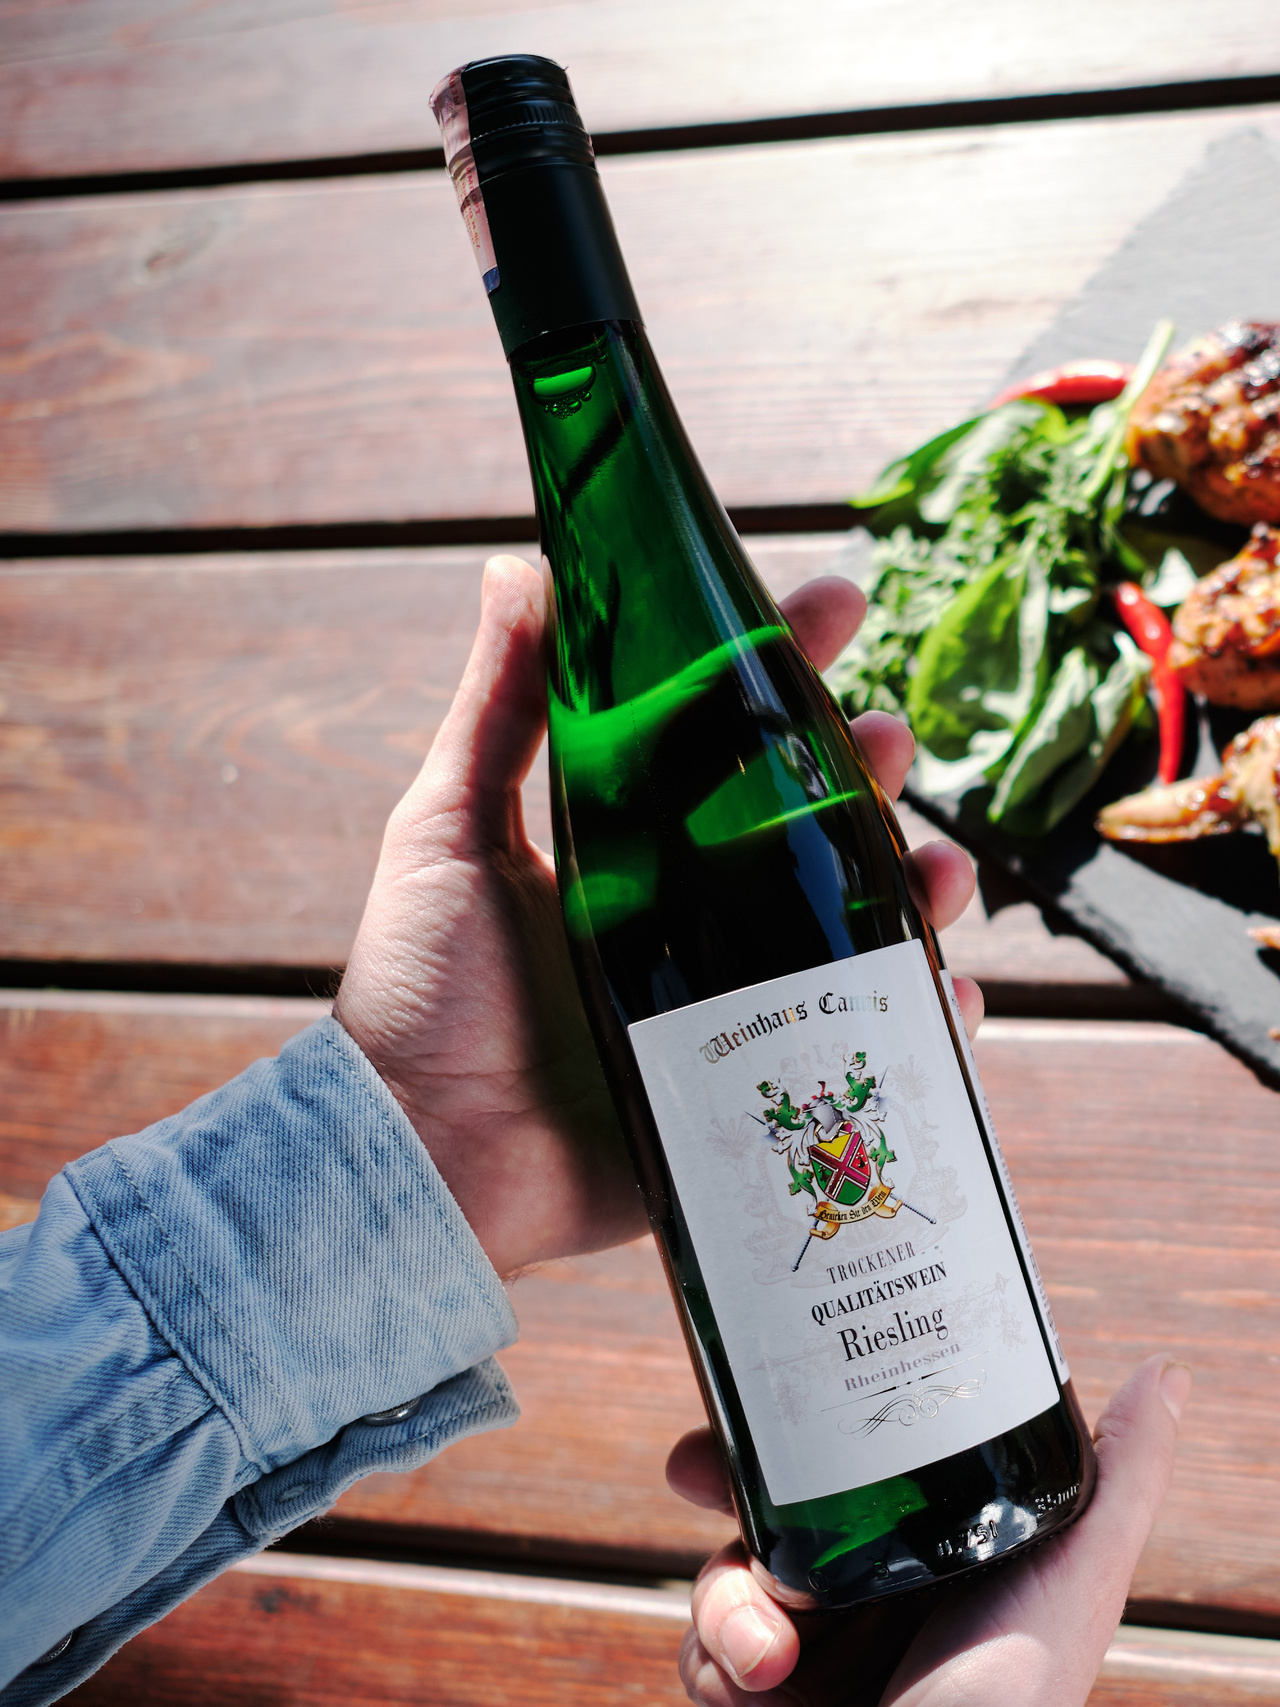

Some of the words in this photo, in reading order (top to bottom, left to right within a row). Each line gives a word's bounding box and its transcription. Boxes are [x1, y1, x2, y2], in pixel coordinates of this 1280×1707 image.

[700, 1001, 808, 1064] Weinhaus
[818, 990, 889, 1015] Cannis
[826, 1240, 917, 1285] TROCKENER
[811, 1261, 948, 1326] QUALITÄTSWEIN
[837, 1308, 949, 1362] Riesling
[843, 1342, 961, 1392] Rheinhessen
